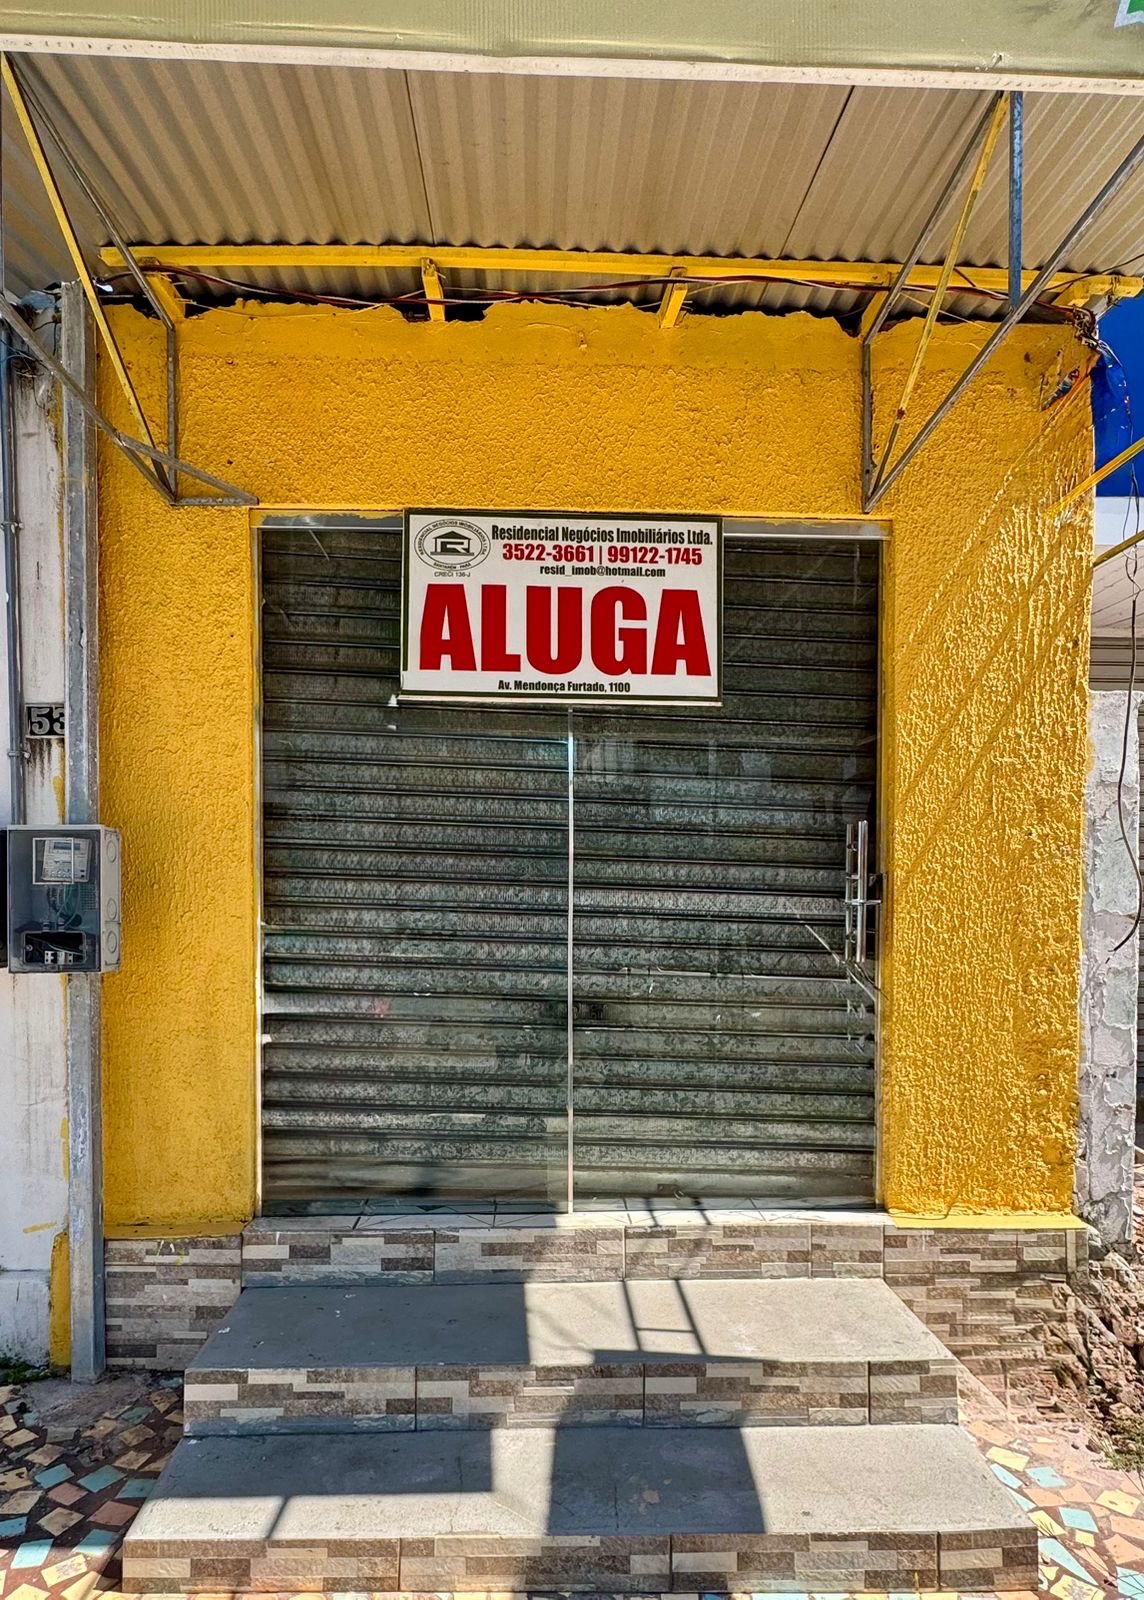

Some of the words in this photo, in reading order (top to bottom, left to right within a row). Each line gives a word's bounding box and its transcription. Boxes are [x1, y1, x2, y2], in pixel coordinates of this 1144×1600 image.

[492, 525, 559, 541] Residencial
[562, 526, 614, 544] Negócios
[617, 527, 685, 544] Imobiliários
[687, 529, 713, 545] Ltda.
[502, 543, 594, 563] 3522-3661
[608, 545, 702, 565] 99122-1745
[540, 565, 666, 578] resid_imob@hotmail.com
[419, 583, 712, 677] ALUGA
[498, 680, 512, 690] Av.
[514, 680, 566, 692] Mendonça
[567, 681, 607, 693] Furtado,
[609, 682, 631, 693] 1100
